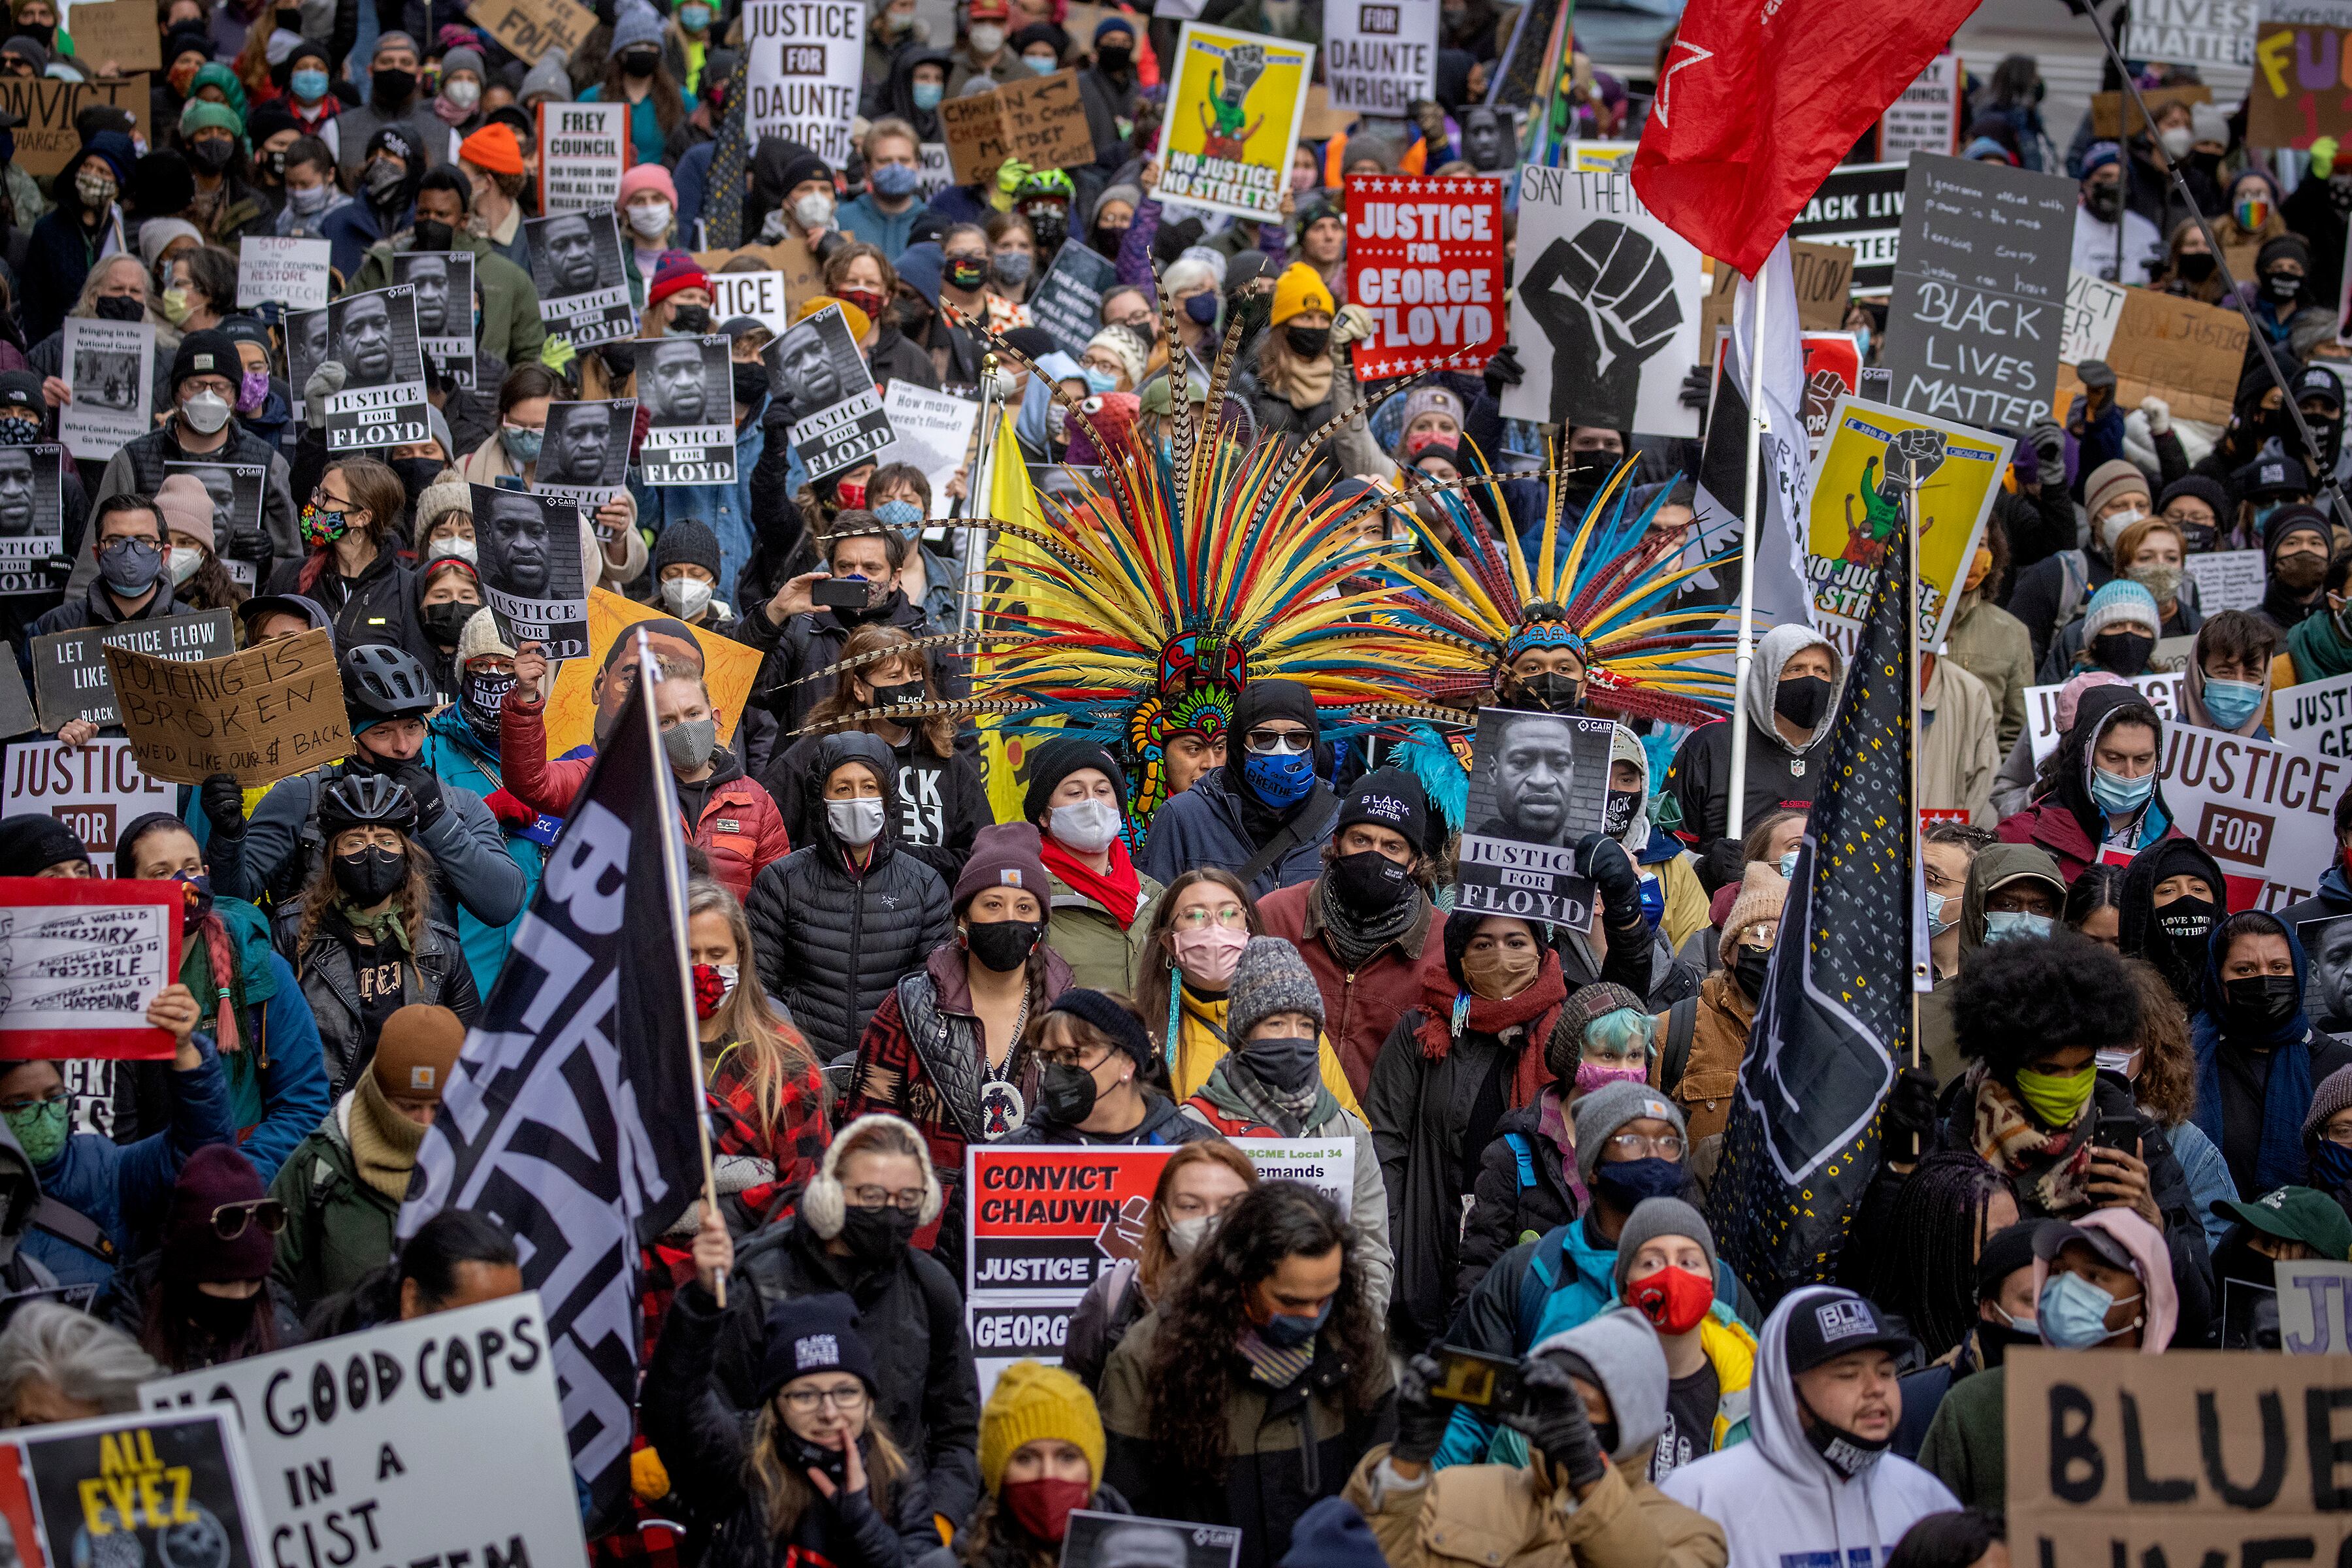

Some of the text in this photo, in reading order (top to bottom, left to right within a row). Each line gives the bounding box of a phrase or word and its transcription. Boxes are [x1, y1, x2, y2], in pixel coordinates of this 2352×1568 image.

[753, 3, 857, 39] JUSTICE
[1362, 7, 1397, 32] FOR
[2129, 26, 2254, 65] MATTER
[787, 48, 823, 74] FOR
[1330, 41, 1428, 74] DAUNTE
[755, 83, 854, 120] DAUNTE
[1333, 74, 1425, 107] WRIGHT
[562, 111, 606, 132] FREY
[551, 139, 617, 155] COUNCIL
[1171, 151, 1277, 189] NO JUSTICE
[1162, 171, 1280, 211] NO STREETS
[1522, 166, 1563, 206] SAY
[1355, 202, 1493, 241] JUSTICE
[259, 237, 298, 251] STOP
[1407, 242, 1441, 263] FOR
[251, 270, 307, 282] RESTORE
[1358, 267, 1492, 305] GEORGE
[239, 284, 323, 301] FREE SPEECH
[547, 289, 622, 319] JUSTICE
[1913, 281, 2043, 340] BLACK
[78, 326, 141, 339] Bringing in the
[1361, 304, 1494, 350] FLOYD
[76, 339, 142, 352] National Guard
[1926, 335, 2036, 392] LIVES
[333, 386, 419, 413] JUSTICE
[896, 395, 957, 417] How many
[1901, 374, 2050, 429] MATTER
[363, 411, 391, 423] FOR
[794, 394, 874, 443] JUSTICE
[925, 414, 962, 431] filmed?
[65, 422, 145, 436] What Could Possibly
[82, 434, 93, 444] Go
[331, 421, 425, 448] FLOYD
[647, 429, 727, 449] JUSTICE
[828, 425, 855, 443] FOR
[1858, 424, 1878, 438] 38th
[675, 451, 700, 459] FOR
[805, 427, 891, 478] FLOYD
[1950, 448, 1978, 459] CHICAGO
[646, 462, 732, 482] FLOYD
[489, 592, 577, 621] JUSTICE
[171, 622, 215, 648] FLOW
[515, 623, 544, 638] FOR
[57, 641, 84, 664] LET
[74, 665, 108, 689] LIKE
[113, 638, 304, 703] POLICING IS
[474, 678, 517, 693] BLACK
[82, 706, 114, 722] BLACK
[125, 679, 314, 738] BROKEN
[1590, 721, 1612, 731] CAIR
[188, 750, 222, 771] LIKE
[229, 751, 262, 769] OUR
[292, 724, 344, 755] BACK
[1269, 772, 1292, 783] can't
[1792, 766, 1804, 774] NFL
[2159, 730, 2340, 817] JUSTICE
[1361, 794, 1411, 816] BLACK
[1367, 807, 1401, 822] MATTER
[1373, 802, 1397, 813] LIVES
[2206, 815, 2264, 857] FOR
[1471, 841, 1570, 872] JUSTIC
[1509, 872, 1546, 888] FOR
[1461, 883, 1586, 923] FLOYD
[138, 910, 148, 920] IS
[2161, 916, 2188, 926] LOVE
[39, 926, 139, 945] NECESSARY
[2165, 926, 2208, 936] MOTHER
[101, 944, 143, 959] WORLD
[146, 941, 158, 951] IS
[49, 957, 142, 978] POSSIBLE
[137, 976, 151, 986] IS
[63, 990, 140, 1012] HAPPENING
[1289, 1149, 1343, 1159] Local 34
[983, 1165, 1119, 1192] CONVICT
[1257, 1164, 1324, 1178] emands
[981, 1198, 1122, 1226] CHAUVIN
[977, 1256, 1089, 1282] JUSTICE
[1823, 1300, 1874, 1331] BLM
[976, 1313, 1072, 1348] GEORG
[265, 1315, 540, 1437] GOOD COPS
[99, 1429, 165, 1478] ALL
[285, 1441, 407, 1509] IN A
[77, 1464, 199, 1537] EYEZ
